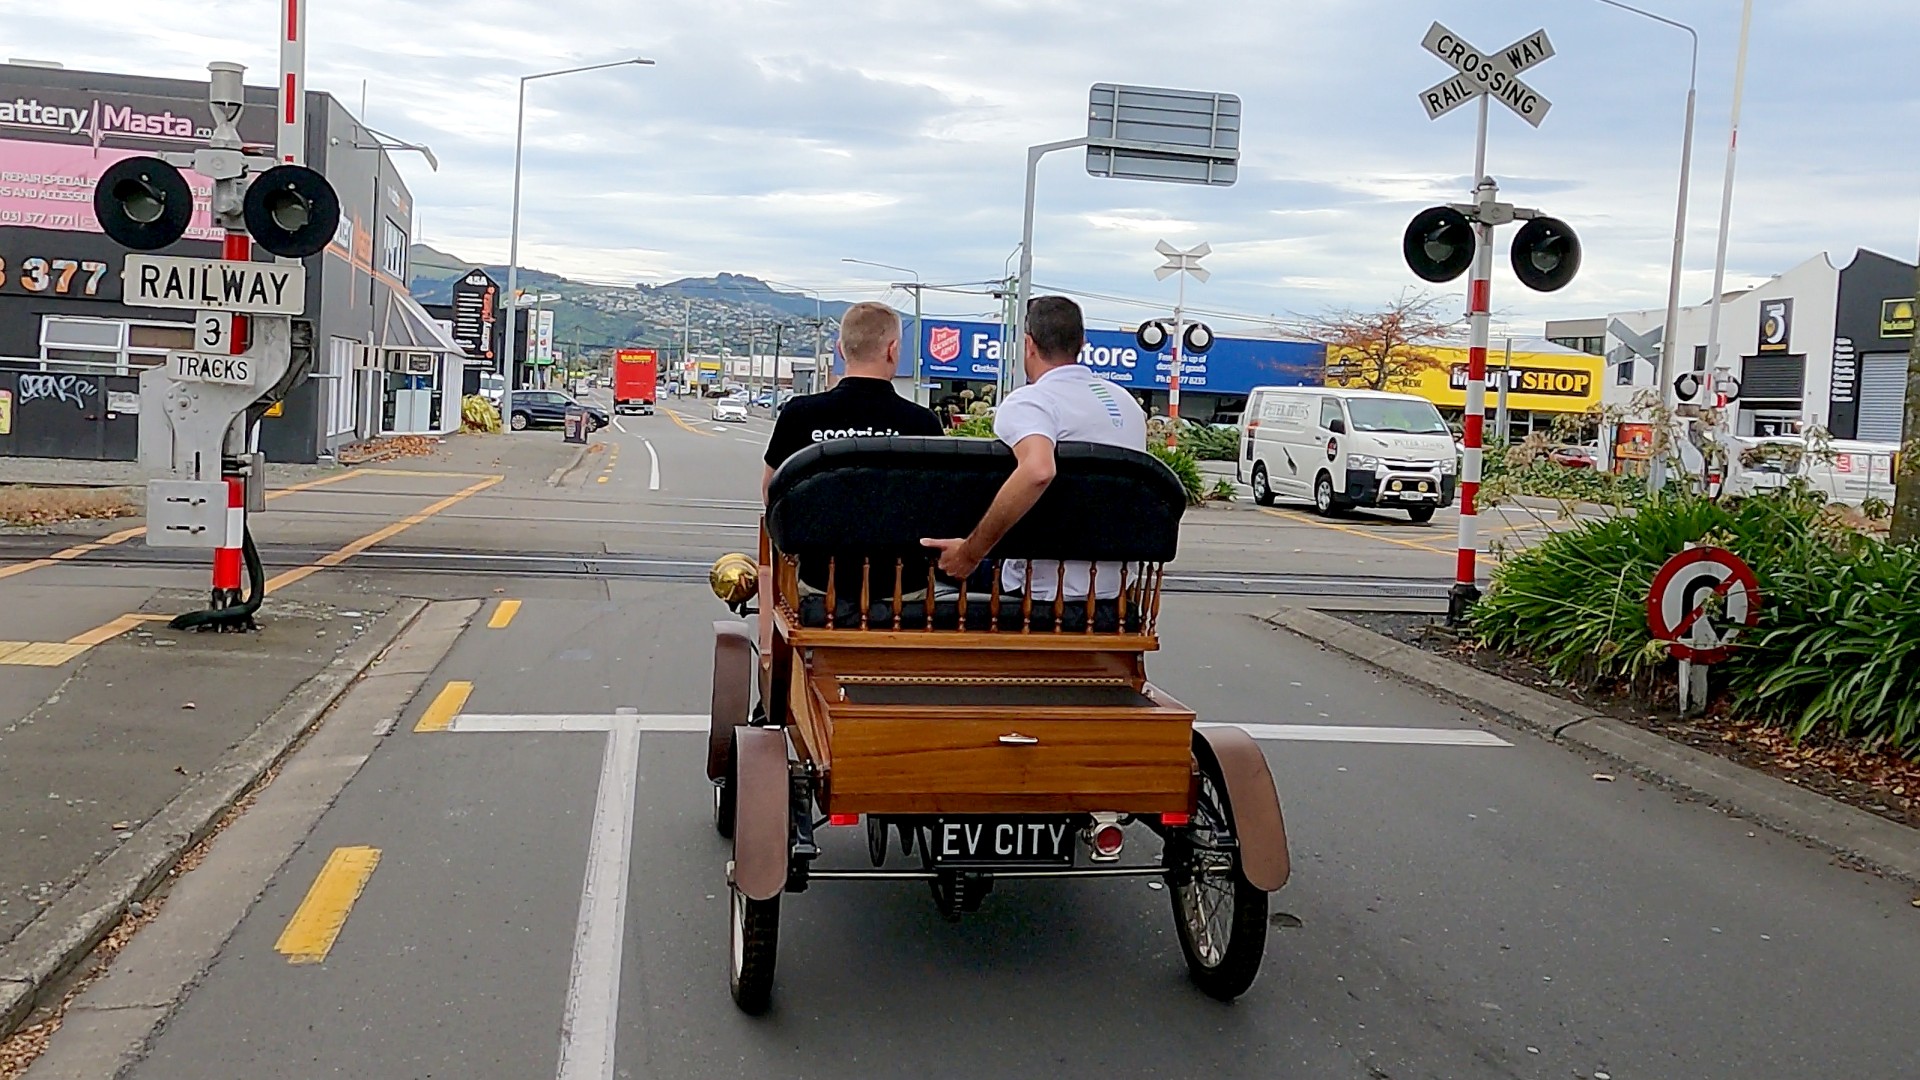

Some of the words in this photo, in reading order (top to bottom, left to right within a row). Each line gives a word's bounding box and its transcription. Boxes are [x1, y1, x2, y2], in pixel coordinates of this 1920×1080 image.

[1426, 79, 1472, 113] RAIL
[1506, 36, 1545, 69] WAY
[1437, 35, 1537, 114] CROSSING
[103, 104, 193, 137] Masta
[2, 171, 40, 184] REPAIR
[14, 187, 37, 198] AND
[20, 257, 108, 296] 377
[139, 264, 290, 306] RAILWAY
[203, 318, 221, 346] 3
[177, 356, 248, 381] TRACKS
[943, 823, 983, 855] EV
[995, 823, 1066, 855] CITY
